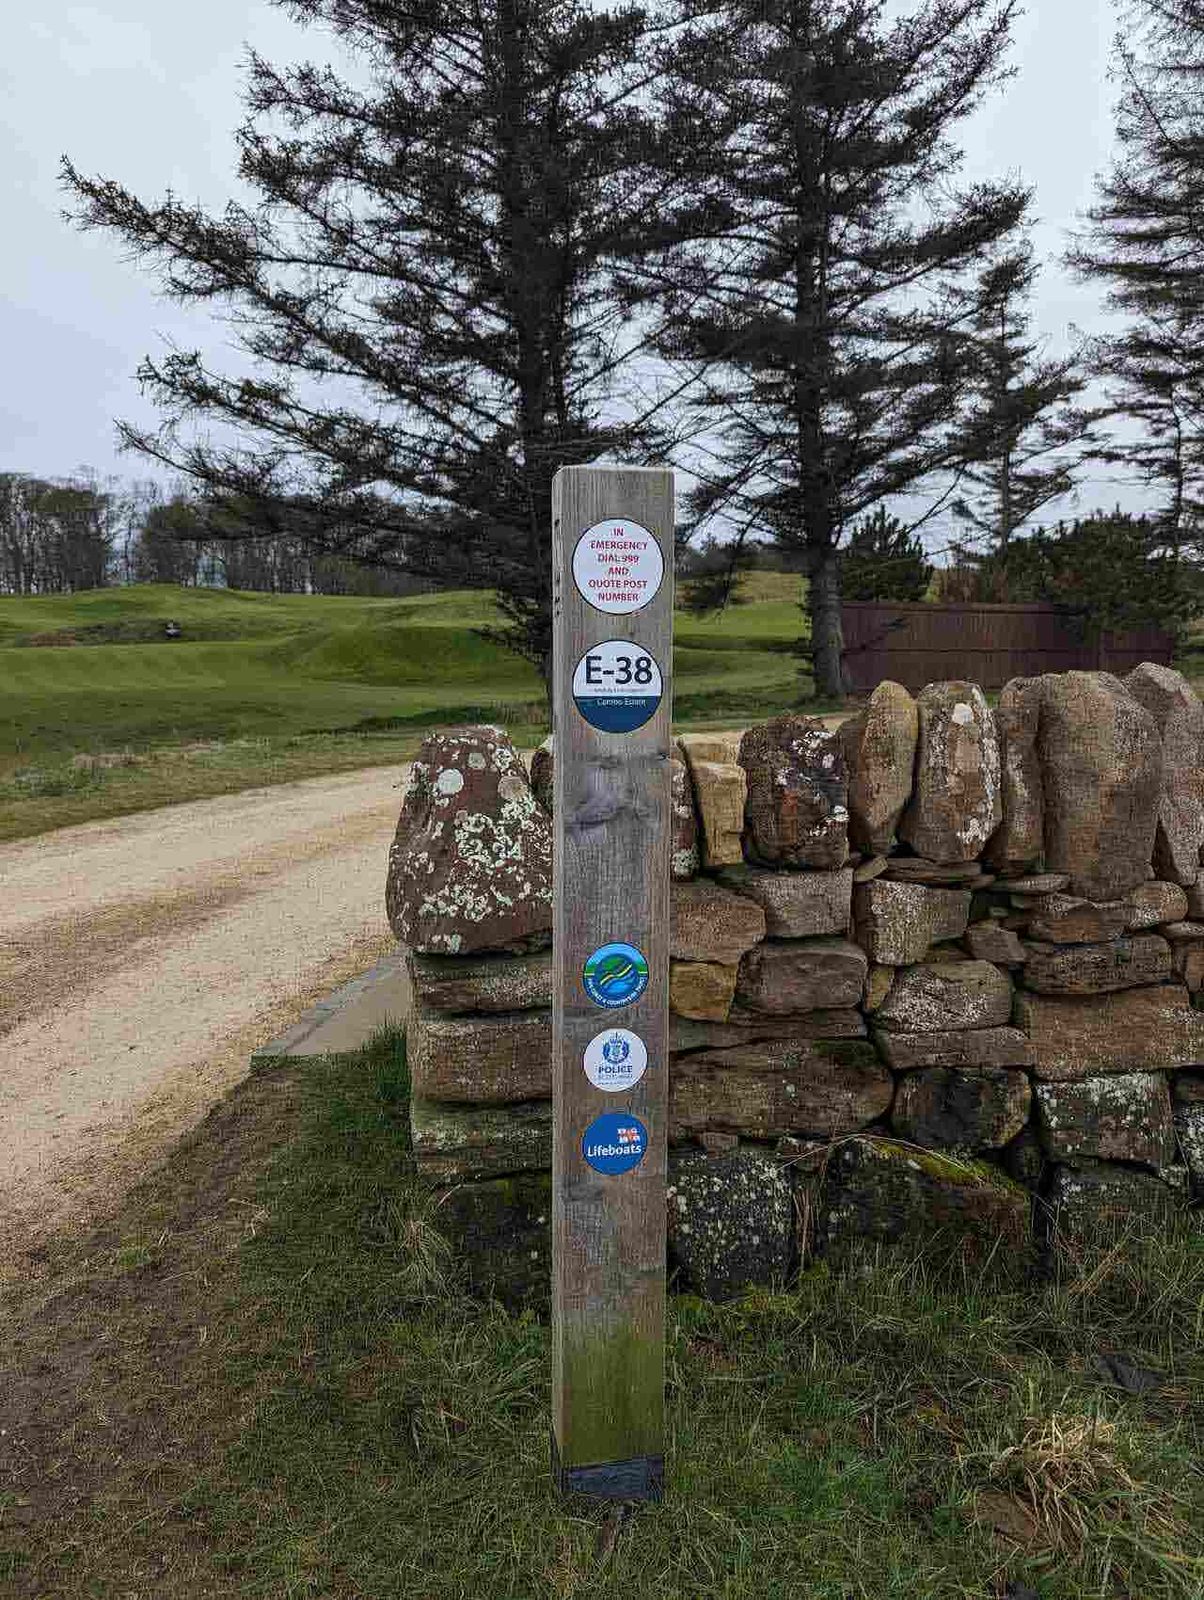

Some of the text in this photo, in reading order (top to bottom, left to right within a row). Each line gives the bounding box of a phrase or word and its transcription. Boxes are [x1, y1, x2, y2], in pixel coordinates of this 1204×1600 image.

[613, 527, 624, 537] IN
[590, 540, 648, 550] EMERGENCY
[597, 553, 640, 563] DIAL 999
[608, 567, 629, 575] AND
[588, 579, 648, 588] QUOTE POST
[598, 592, 639, 602] NUMBER
[585, 655, 653, 685] E-38
[598, 1065, 633, 1074] POLICE
[587, 1143, 642, 1157] Lifeboats
